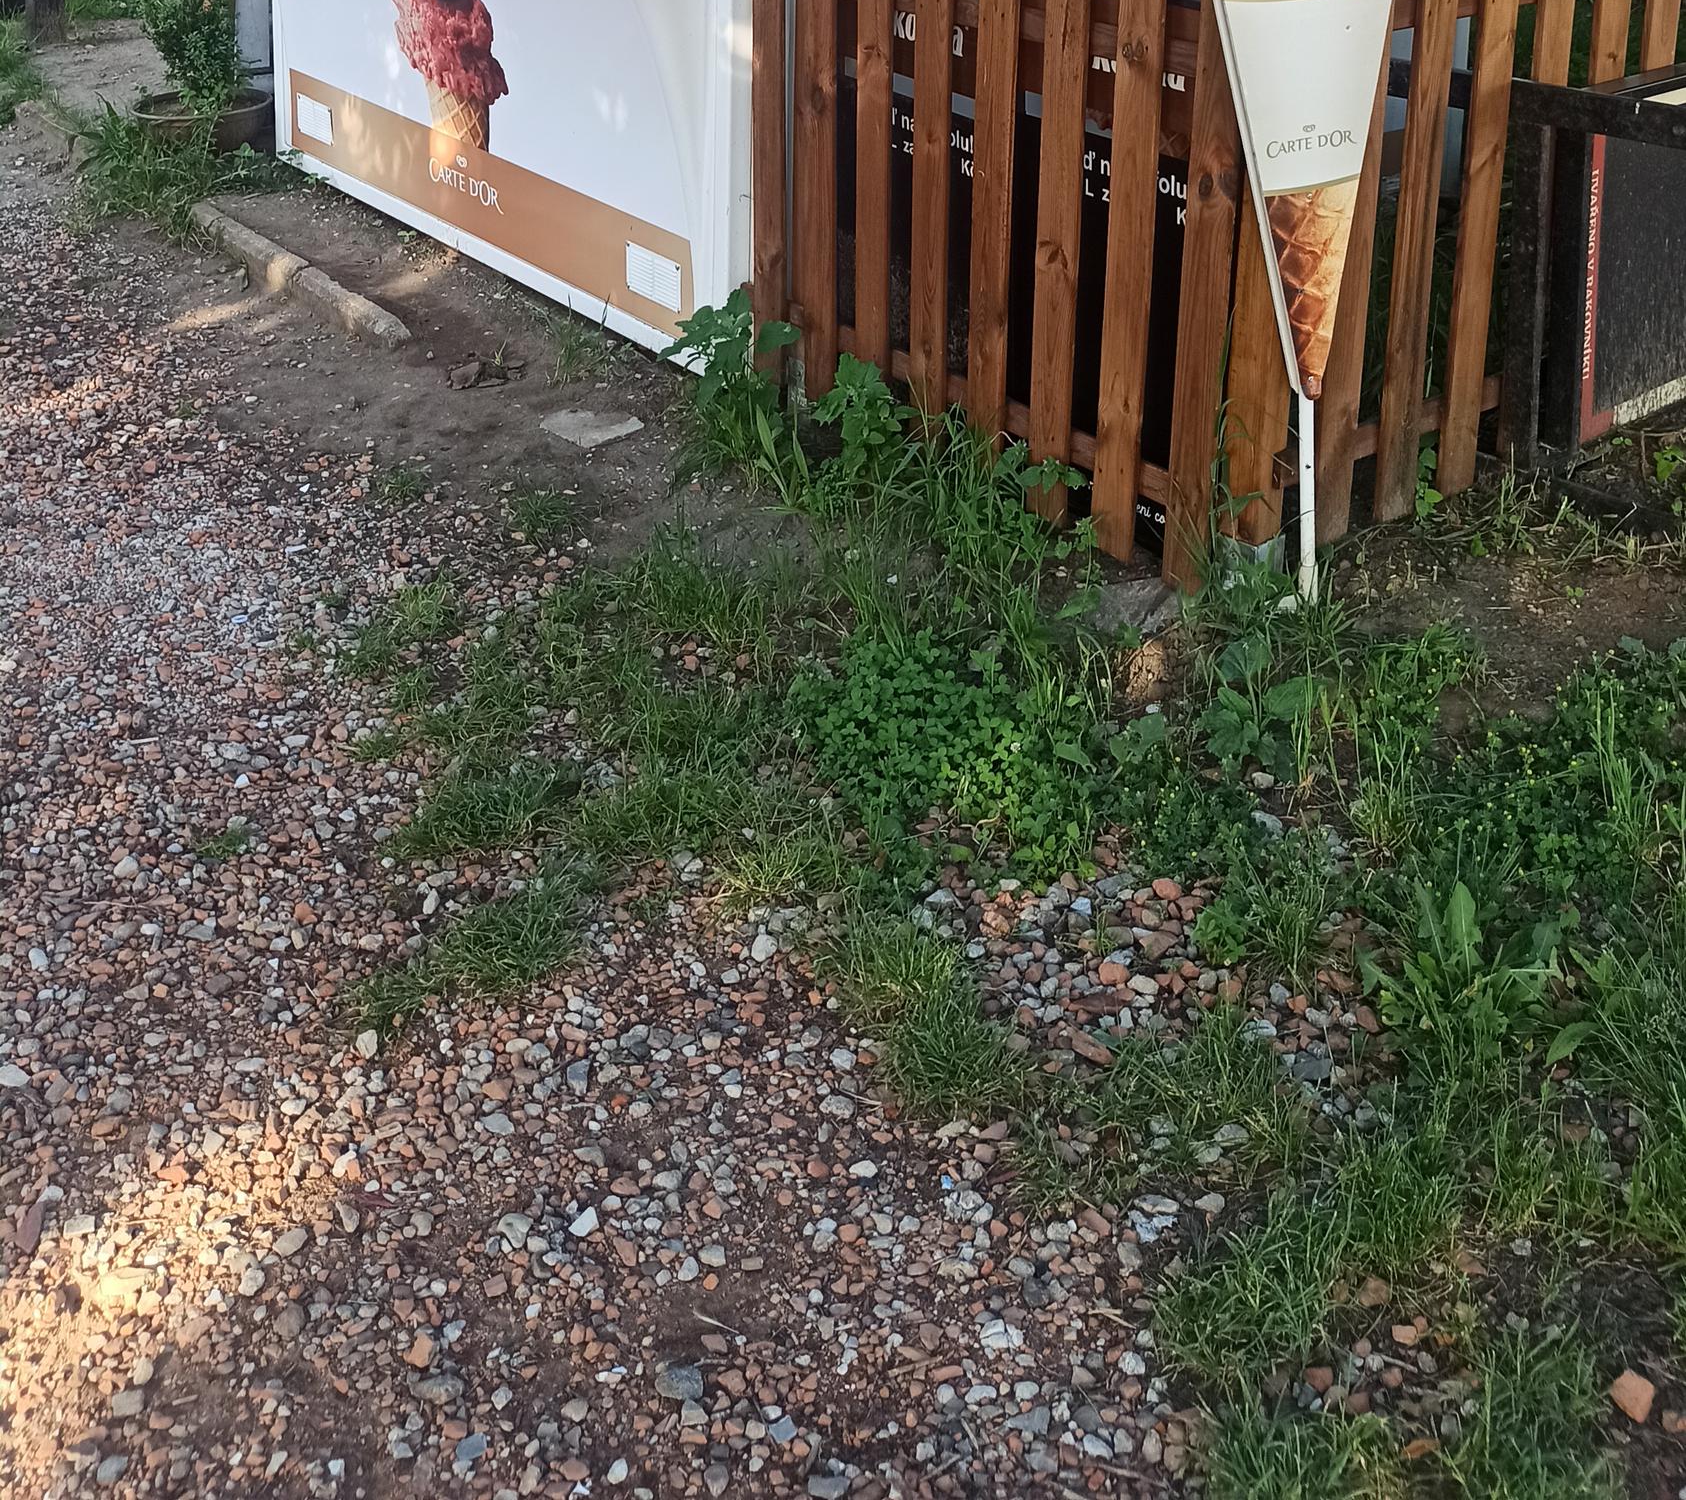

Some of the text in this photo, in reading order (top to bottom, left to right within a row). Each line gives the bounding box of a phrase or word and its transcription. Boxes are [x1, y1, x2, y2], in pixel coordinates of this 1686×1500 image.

[1266, 130, 1357, 158] CARTE D'OR
[429, 157, 504, 215] CARTE D'OR
[1587, 169, 1600, 255] UVAŘENO
[1587, 257, 1595, 270] V
